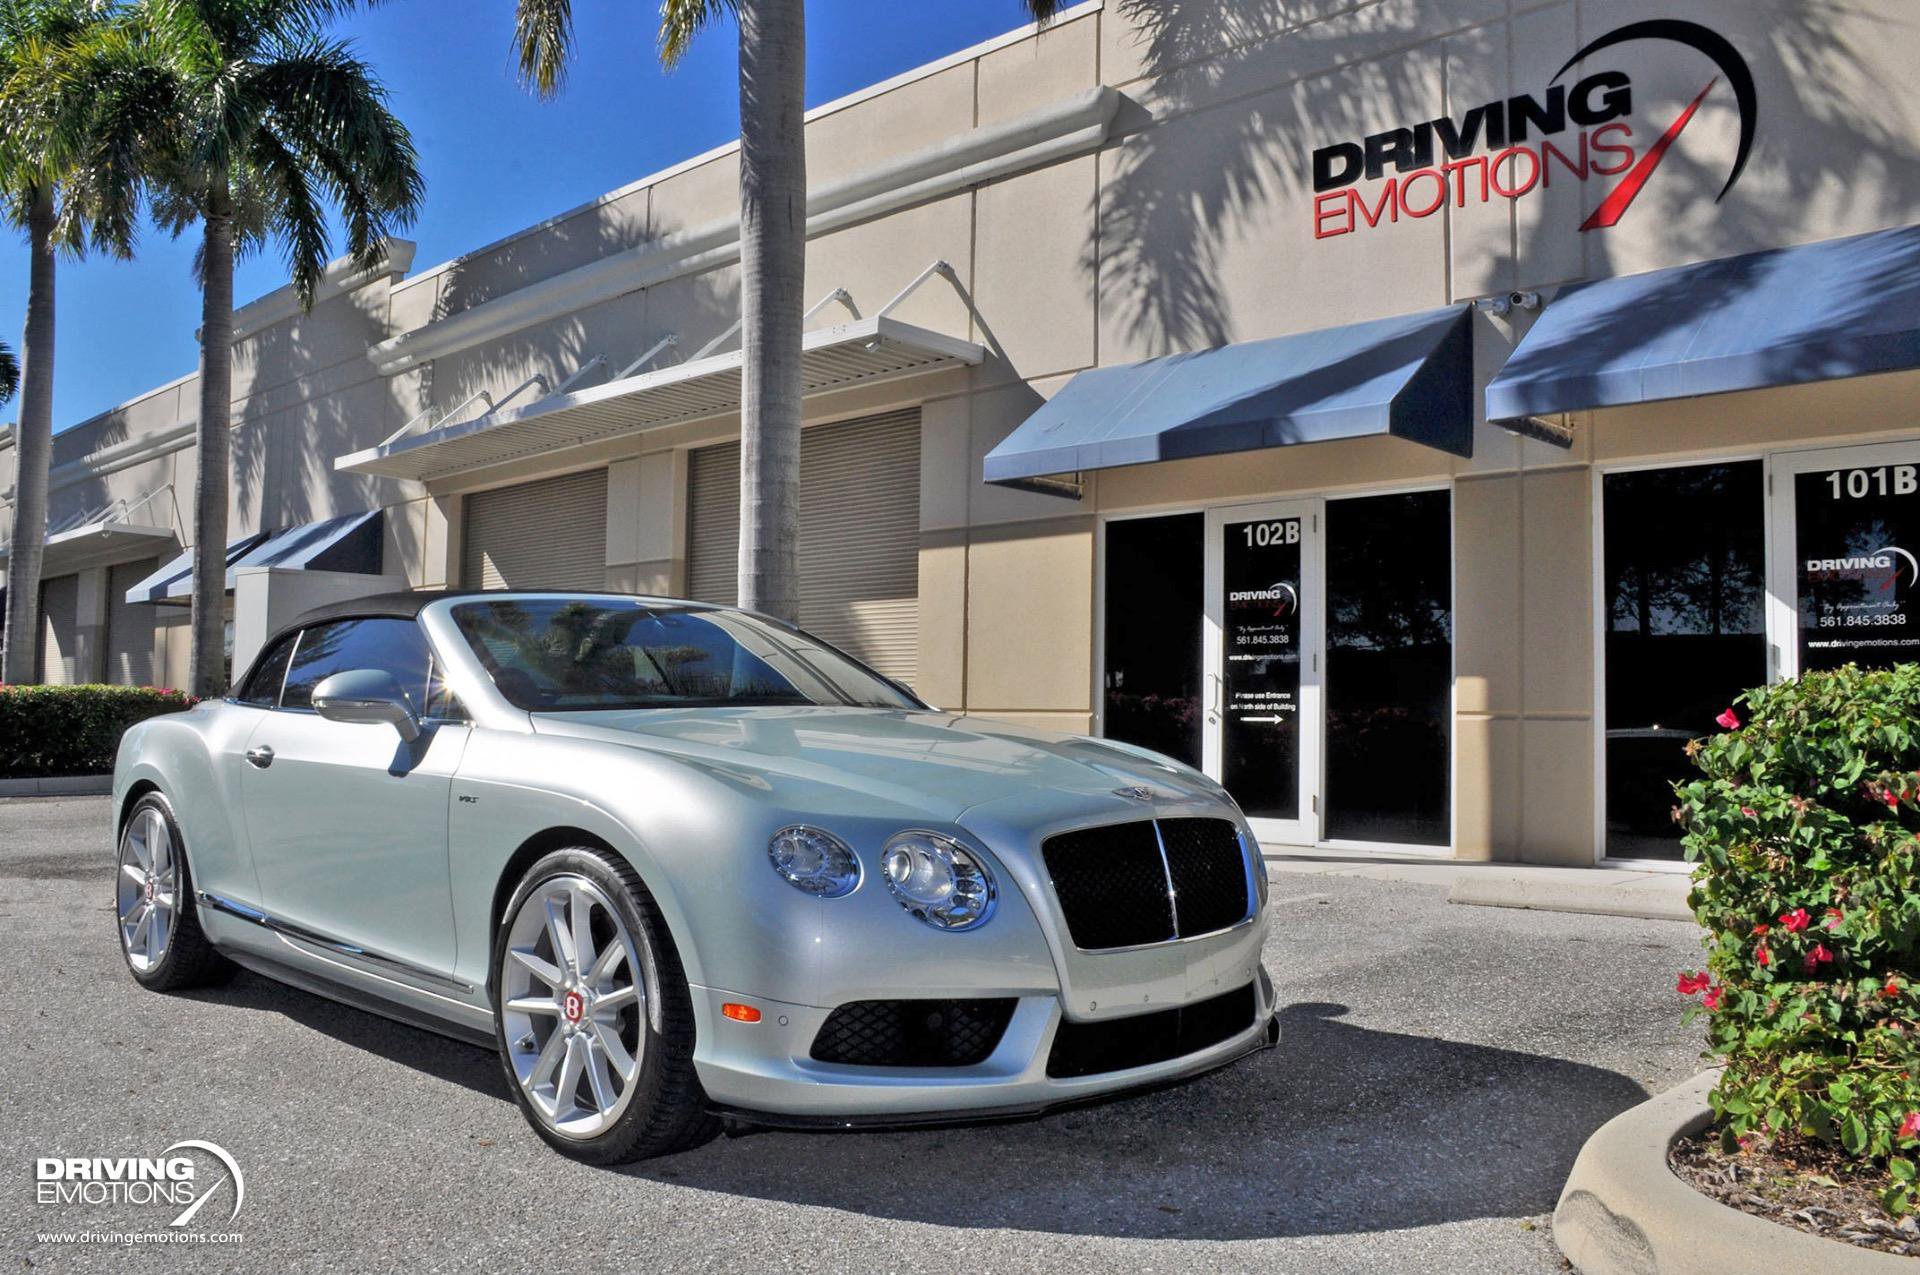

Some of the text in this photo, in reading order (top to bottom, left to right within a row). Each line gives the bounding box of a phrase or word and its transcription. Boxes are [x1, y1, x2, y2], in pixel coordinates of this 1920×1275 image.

[1313, 71, 1632, 193] DRIVING
[1314, 123, 1635, 239] EMOTIONS
[1825, 465, 1918, 499] 101B
[1243, 521, 1300, 546] 102B
[1806, 556, 1891, 571] DRIVING
[1229, 590, 1281, 601] DRIVING
[1820, 613, 1906, 627] 561.845.3838
[1236, 634, 1289, 645] 561.845.3838
[1807, 638, 1920, 649] www.drivingemotions.com
[1265, 691, 1291, 699] Entrance
[1273, 702, 1296, 711] Building
